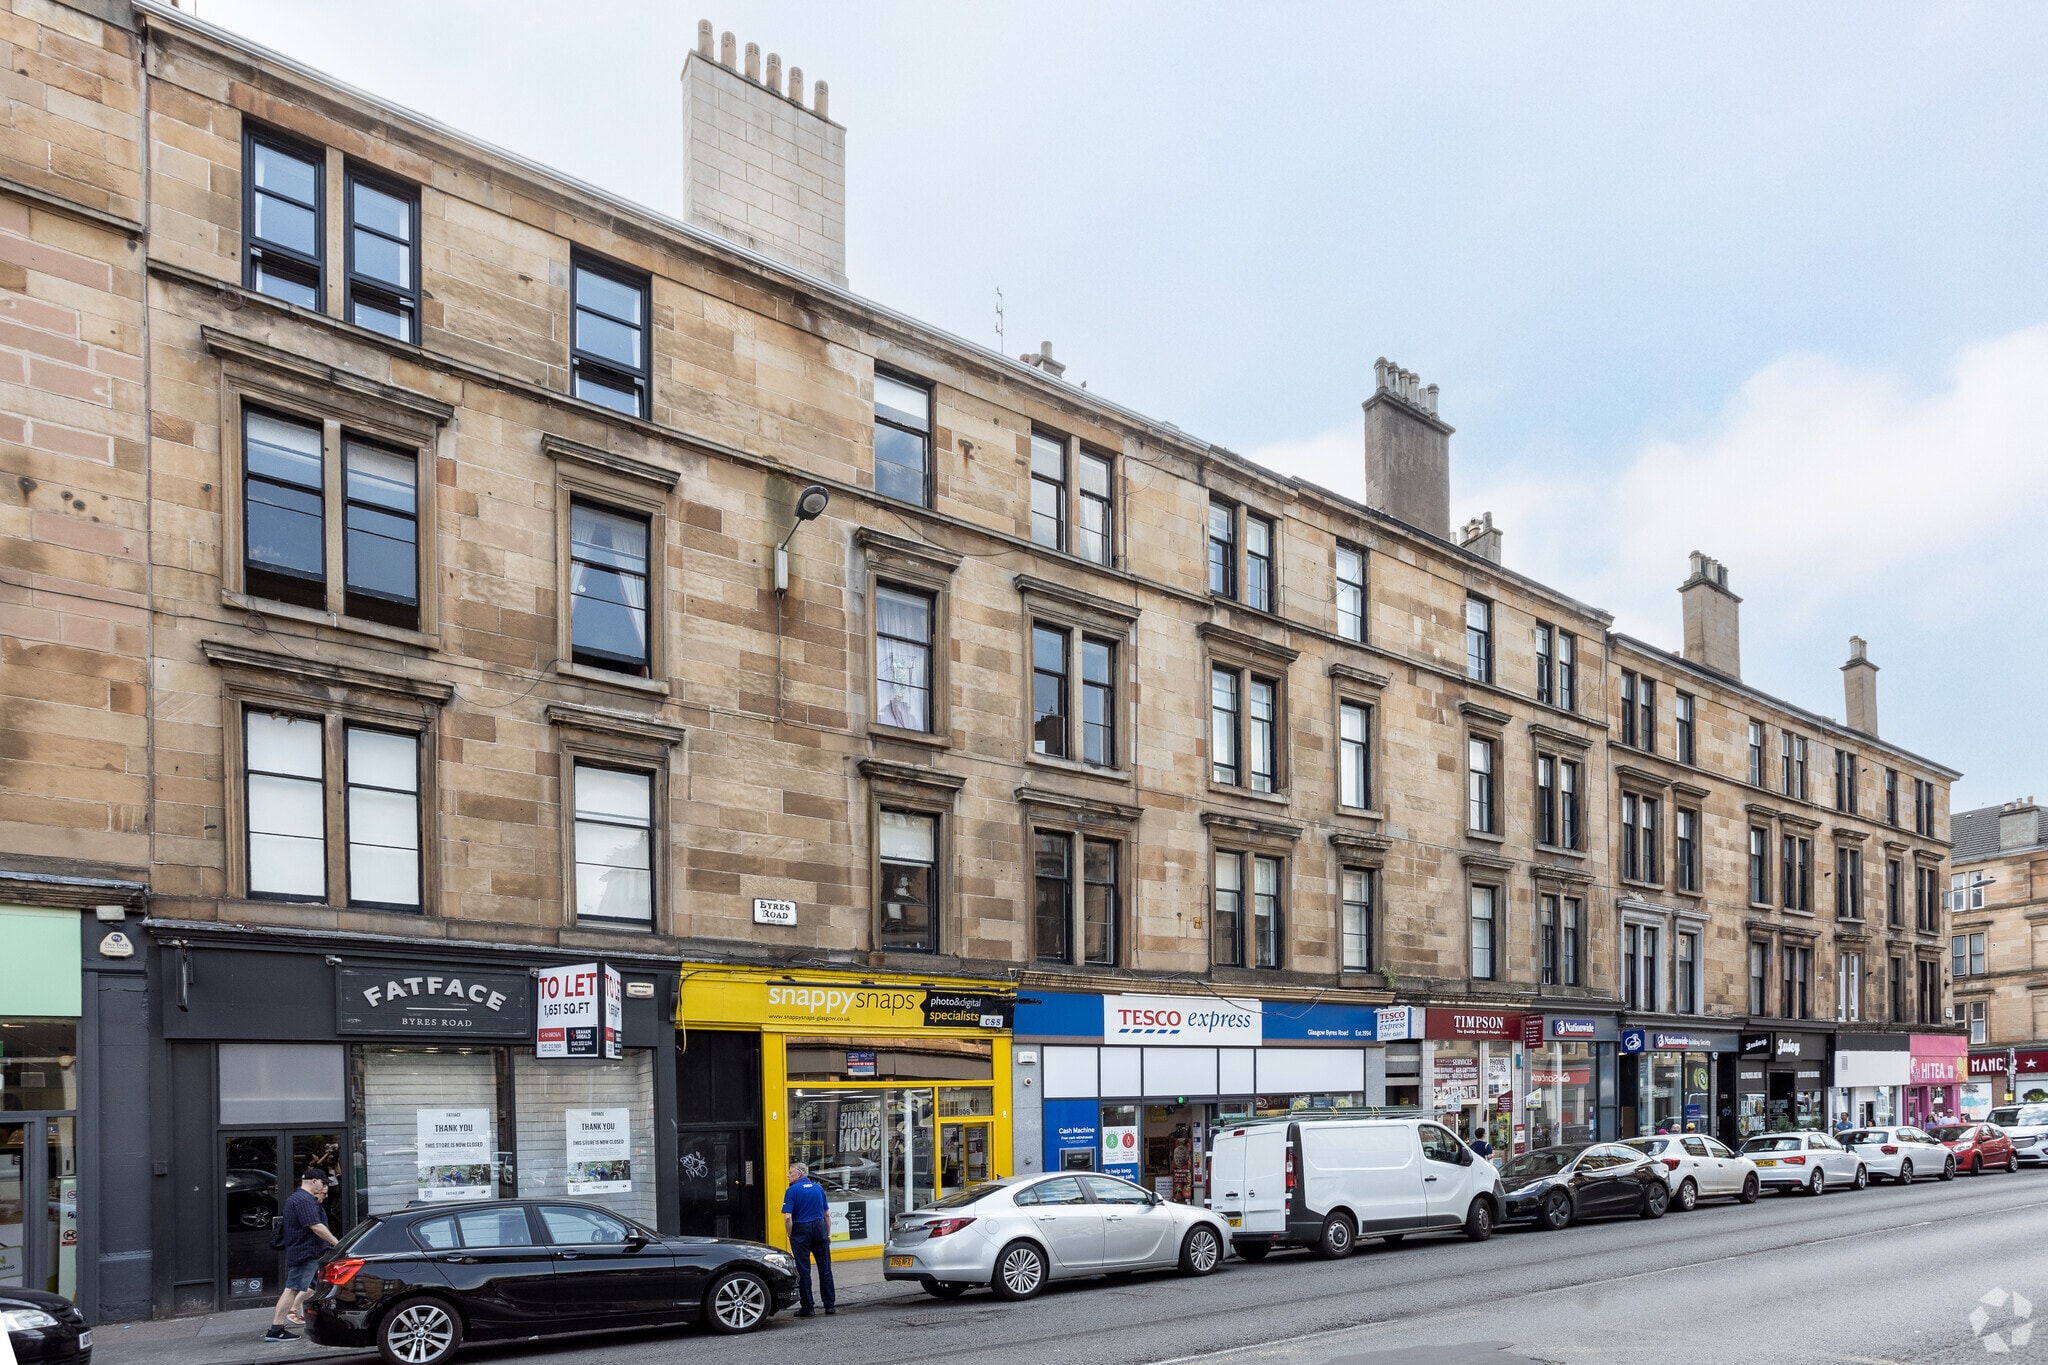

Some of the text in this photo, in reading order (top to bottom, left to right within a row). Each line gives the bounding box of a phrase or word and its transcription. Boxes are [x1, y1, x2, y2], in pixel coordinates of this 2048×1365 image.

[762, 910, 789, 920] ROAD
[539, 973, 597, 1000] TO LET
[363, 976, 507, 1012] FATFACE
[930, 996, 982, 1009] photo&digital
[543, 1002, 562, 1018] 1,651
[563, 1002, 590, 1015] SQ.FT
[1380, 1011, 1406, 1020] TESCO
[402, 1017, 473, 1027] BYRES ROAD
[929, 1010, 980, 1023] specialists
[1117, 1009, 1251, 1033] TESCO express
[1454, 1015, 1504, 1029] TIMPSON
[1380, 1021, 1406, 1032] express
[1565, 1022, 1595, 1033] Nationwide
[1307, 1028, 1326, 1037] Glasgow
[1326, 1029, 1337, 1037] Byres
[1664, 1035, 1689, 1046] Nationwide
[1777, 1038, 1801, 1057] Juicy
[434, 1124, 473, 1133] THANK YOU
[581, 1122, 616, 1131] THANK YOU
[1073, 1126, 1096, 1134] Machine
